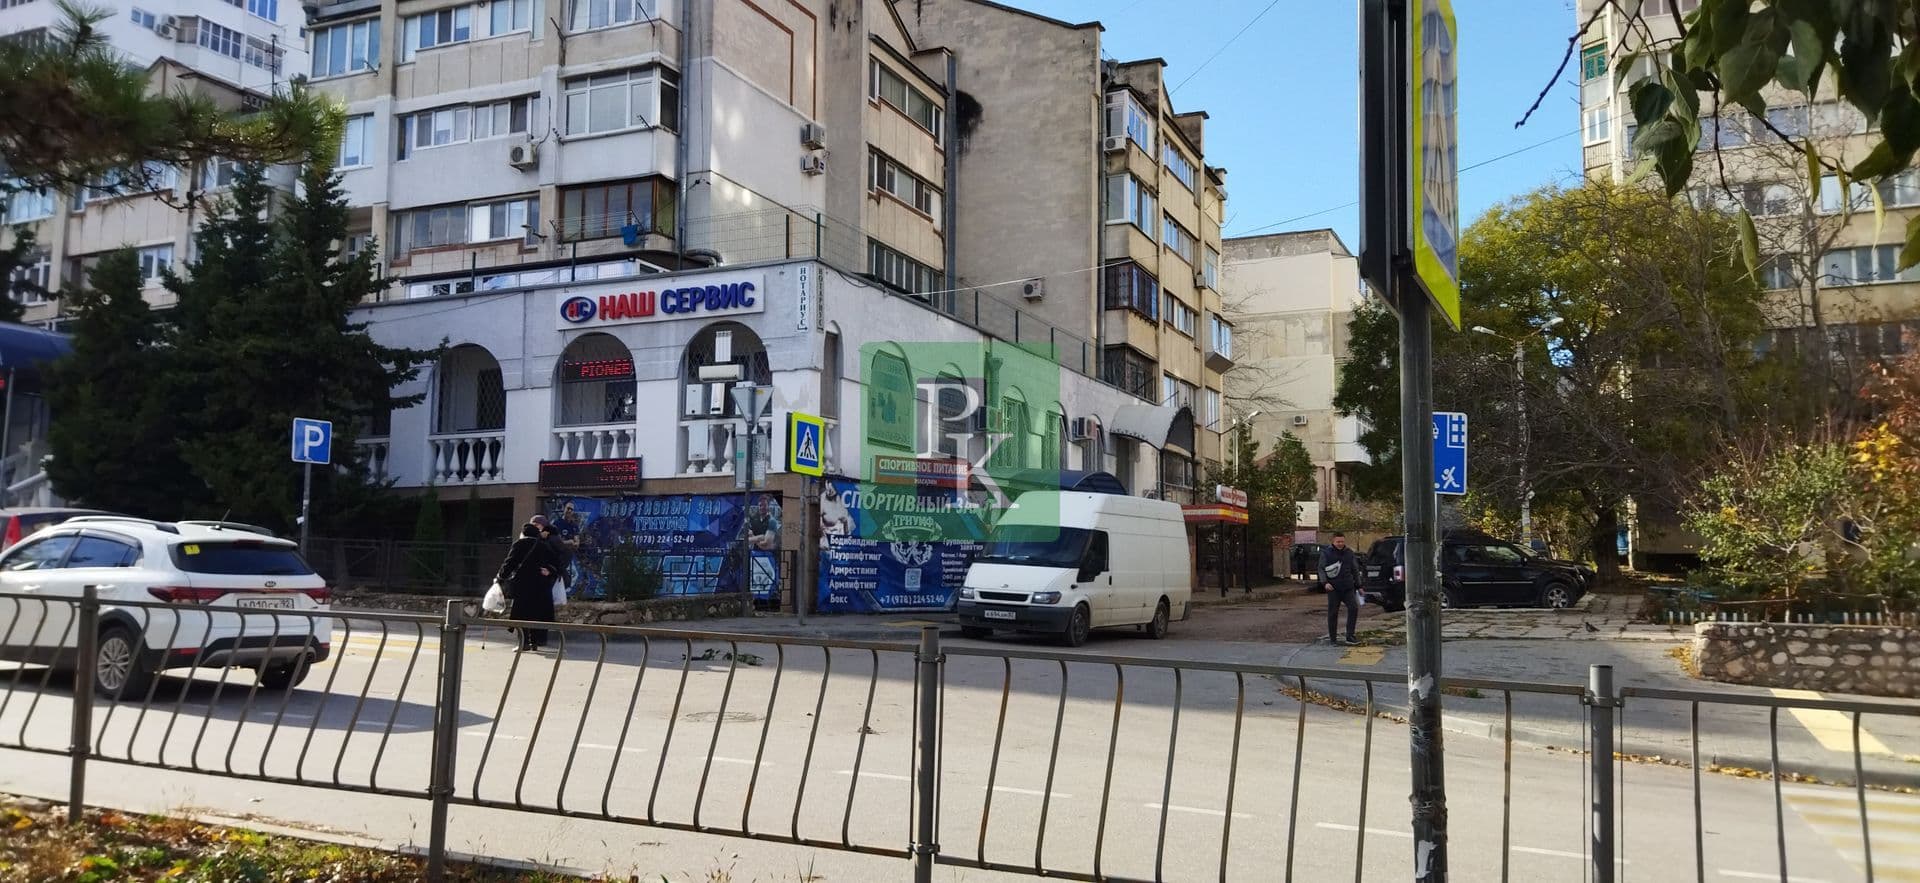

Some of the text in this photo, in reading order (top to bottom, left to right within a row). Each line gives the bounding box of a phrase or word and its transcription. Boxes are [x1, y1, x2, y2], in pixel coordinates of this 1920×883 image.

[599, 282, 756, 320] НАШ СЕРВИС
[304, 425, 325, 458] P
[879, 459, 969, 474] СПОРТИВНОЕ ПИТАНИЕ
[601, 498, 721, 517] СПОРТИВНЫЙ ЗАЛ
[841, 489, 951, 514] СПОРТИВНЫЙ
[633, 516, 688, 532] ТРИУМФ
[893, 514, 934, 527] ТРИУМФ
[830, 535, 878, 548] Бодибилдинг
[830, 550, 882, 562] Пауэрлифтинг
[829, 564, 878, 576] Армрестлинг
[829, 579, 877, 590] Армлифтинг
[830, 594, 848, 604] Бокс
